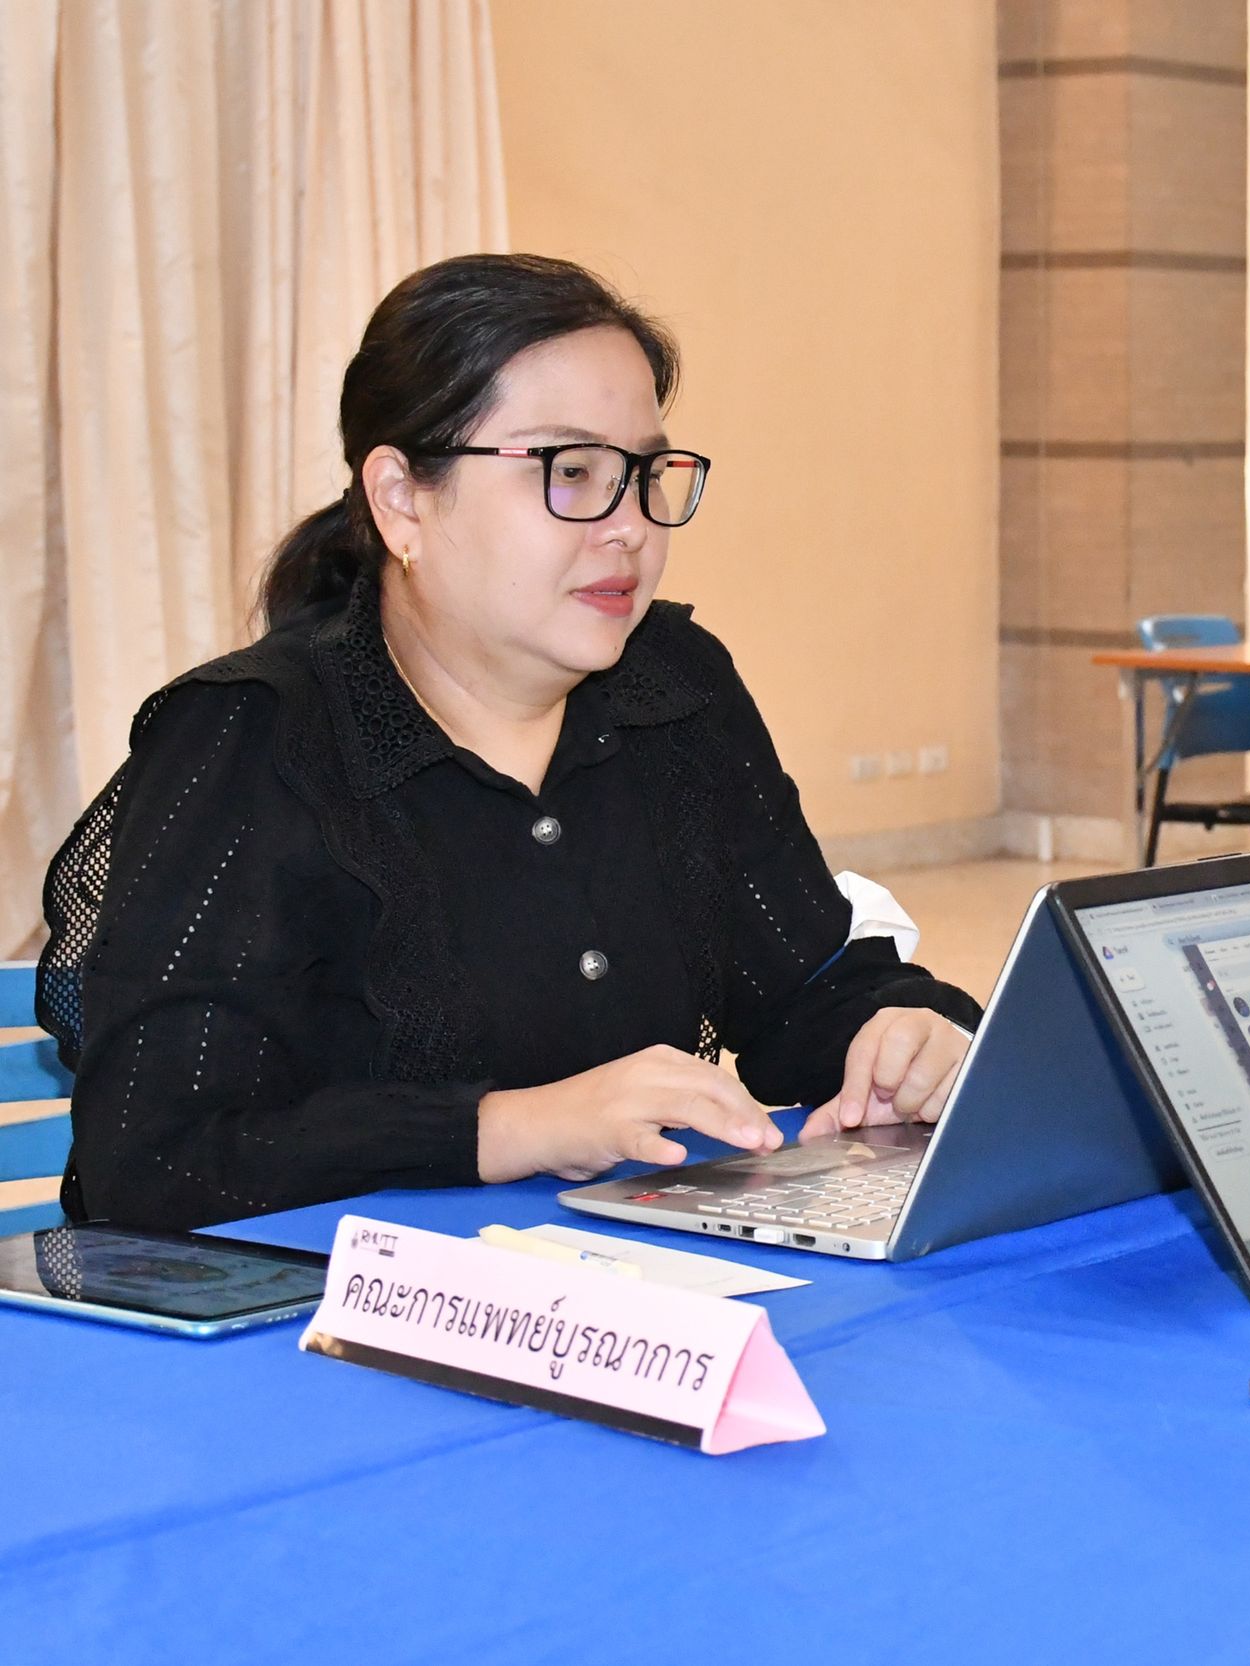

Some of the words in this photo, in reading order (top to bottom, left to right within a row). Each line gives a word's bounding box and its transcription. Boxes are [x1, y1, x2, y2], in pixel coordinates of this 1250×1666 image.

[341, 1272, 716, 1392] คณะการแพทย์บูรณาการ
